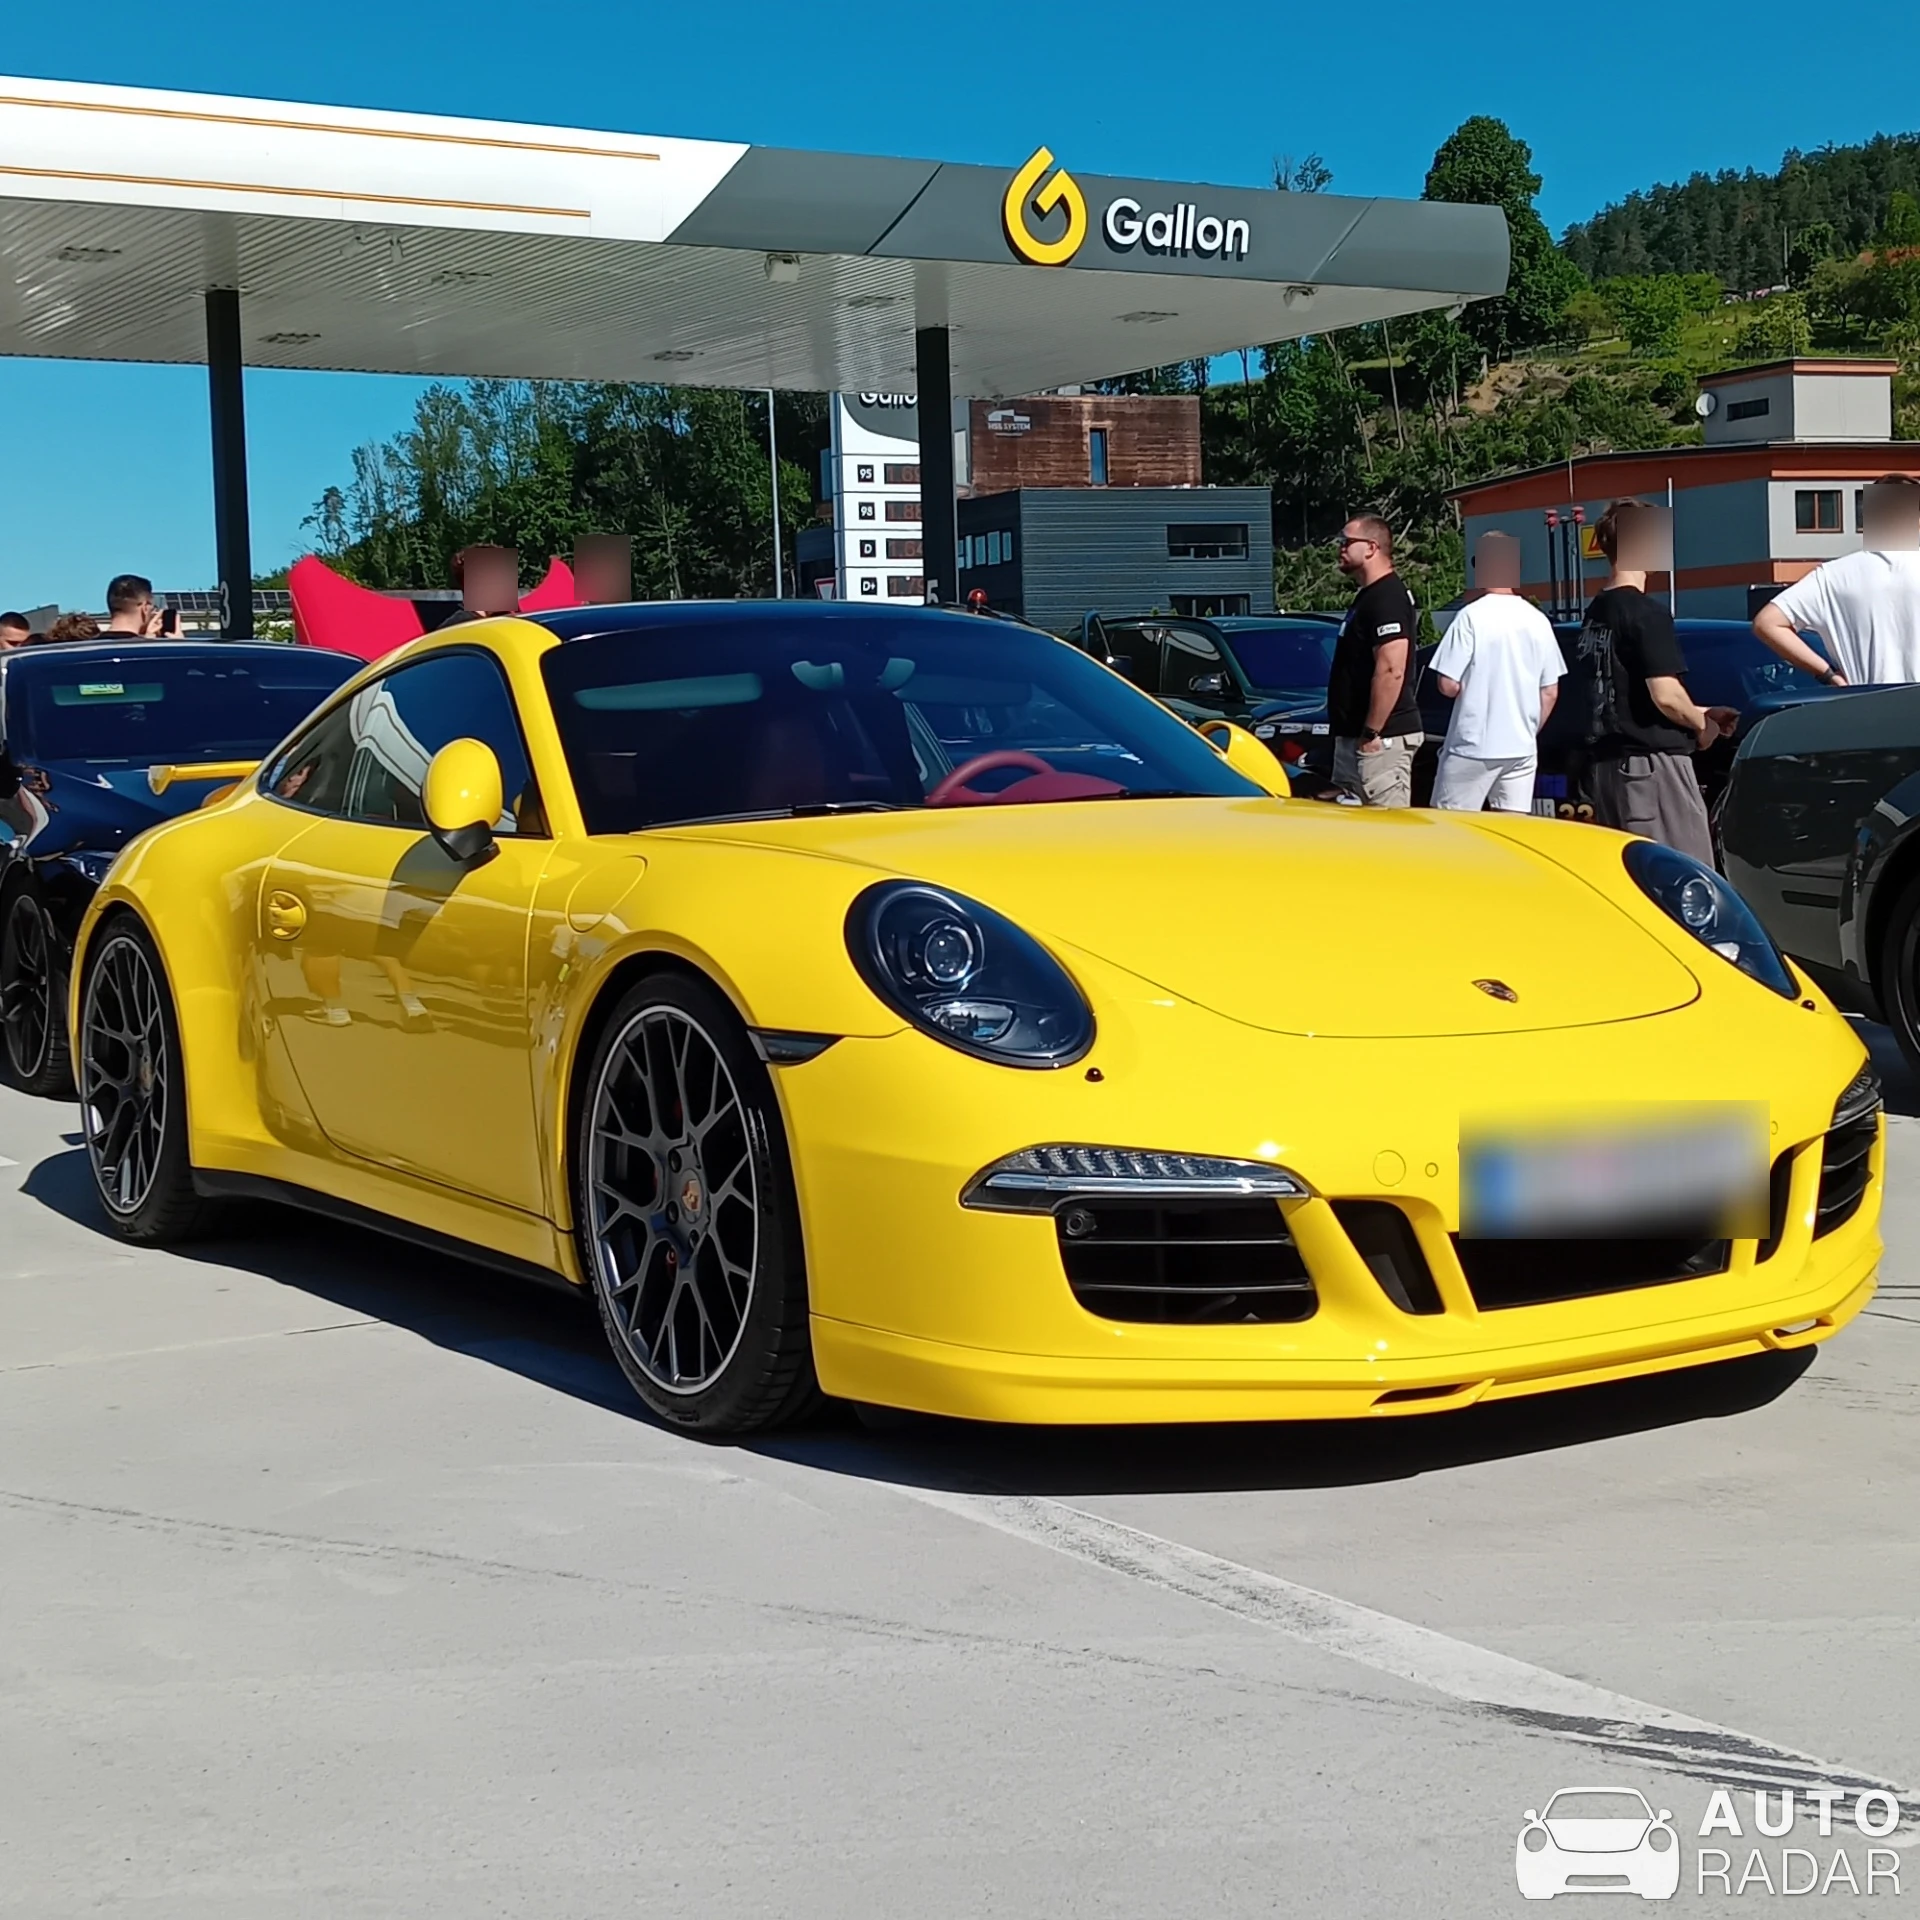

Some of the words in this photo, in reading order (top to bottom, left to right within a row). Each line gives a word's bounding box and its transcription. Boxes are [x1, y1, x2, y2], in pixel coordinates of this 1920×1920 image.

[1106, 197, 1250, 254] Gallon
[860, 392, 918, 405] Gallo
[859, 468, 872, 479] 95
[860, 506, 873, 517] 98
[863, 544, 872, 554] D
[862, 581, 876, 592] D+
[220, 580, 231, 629] 3
